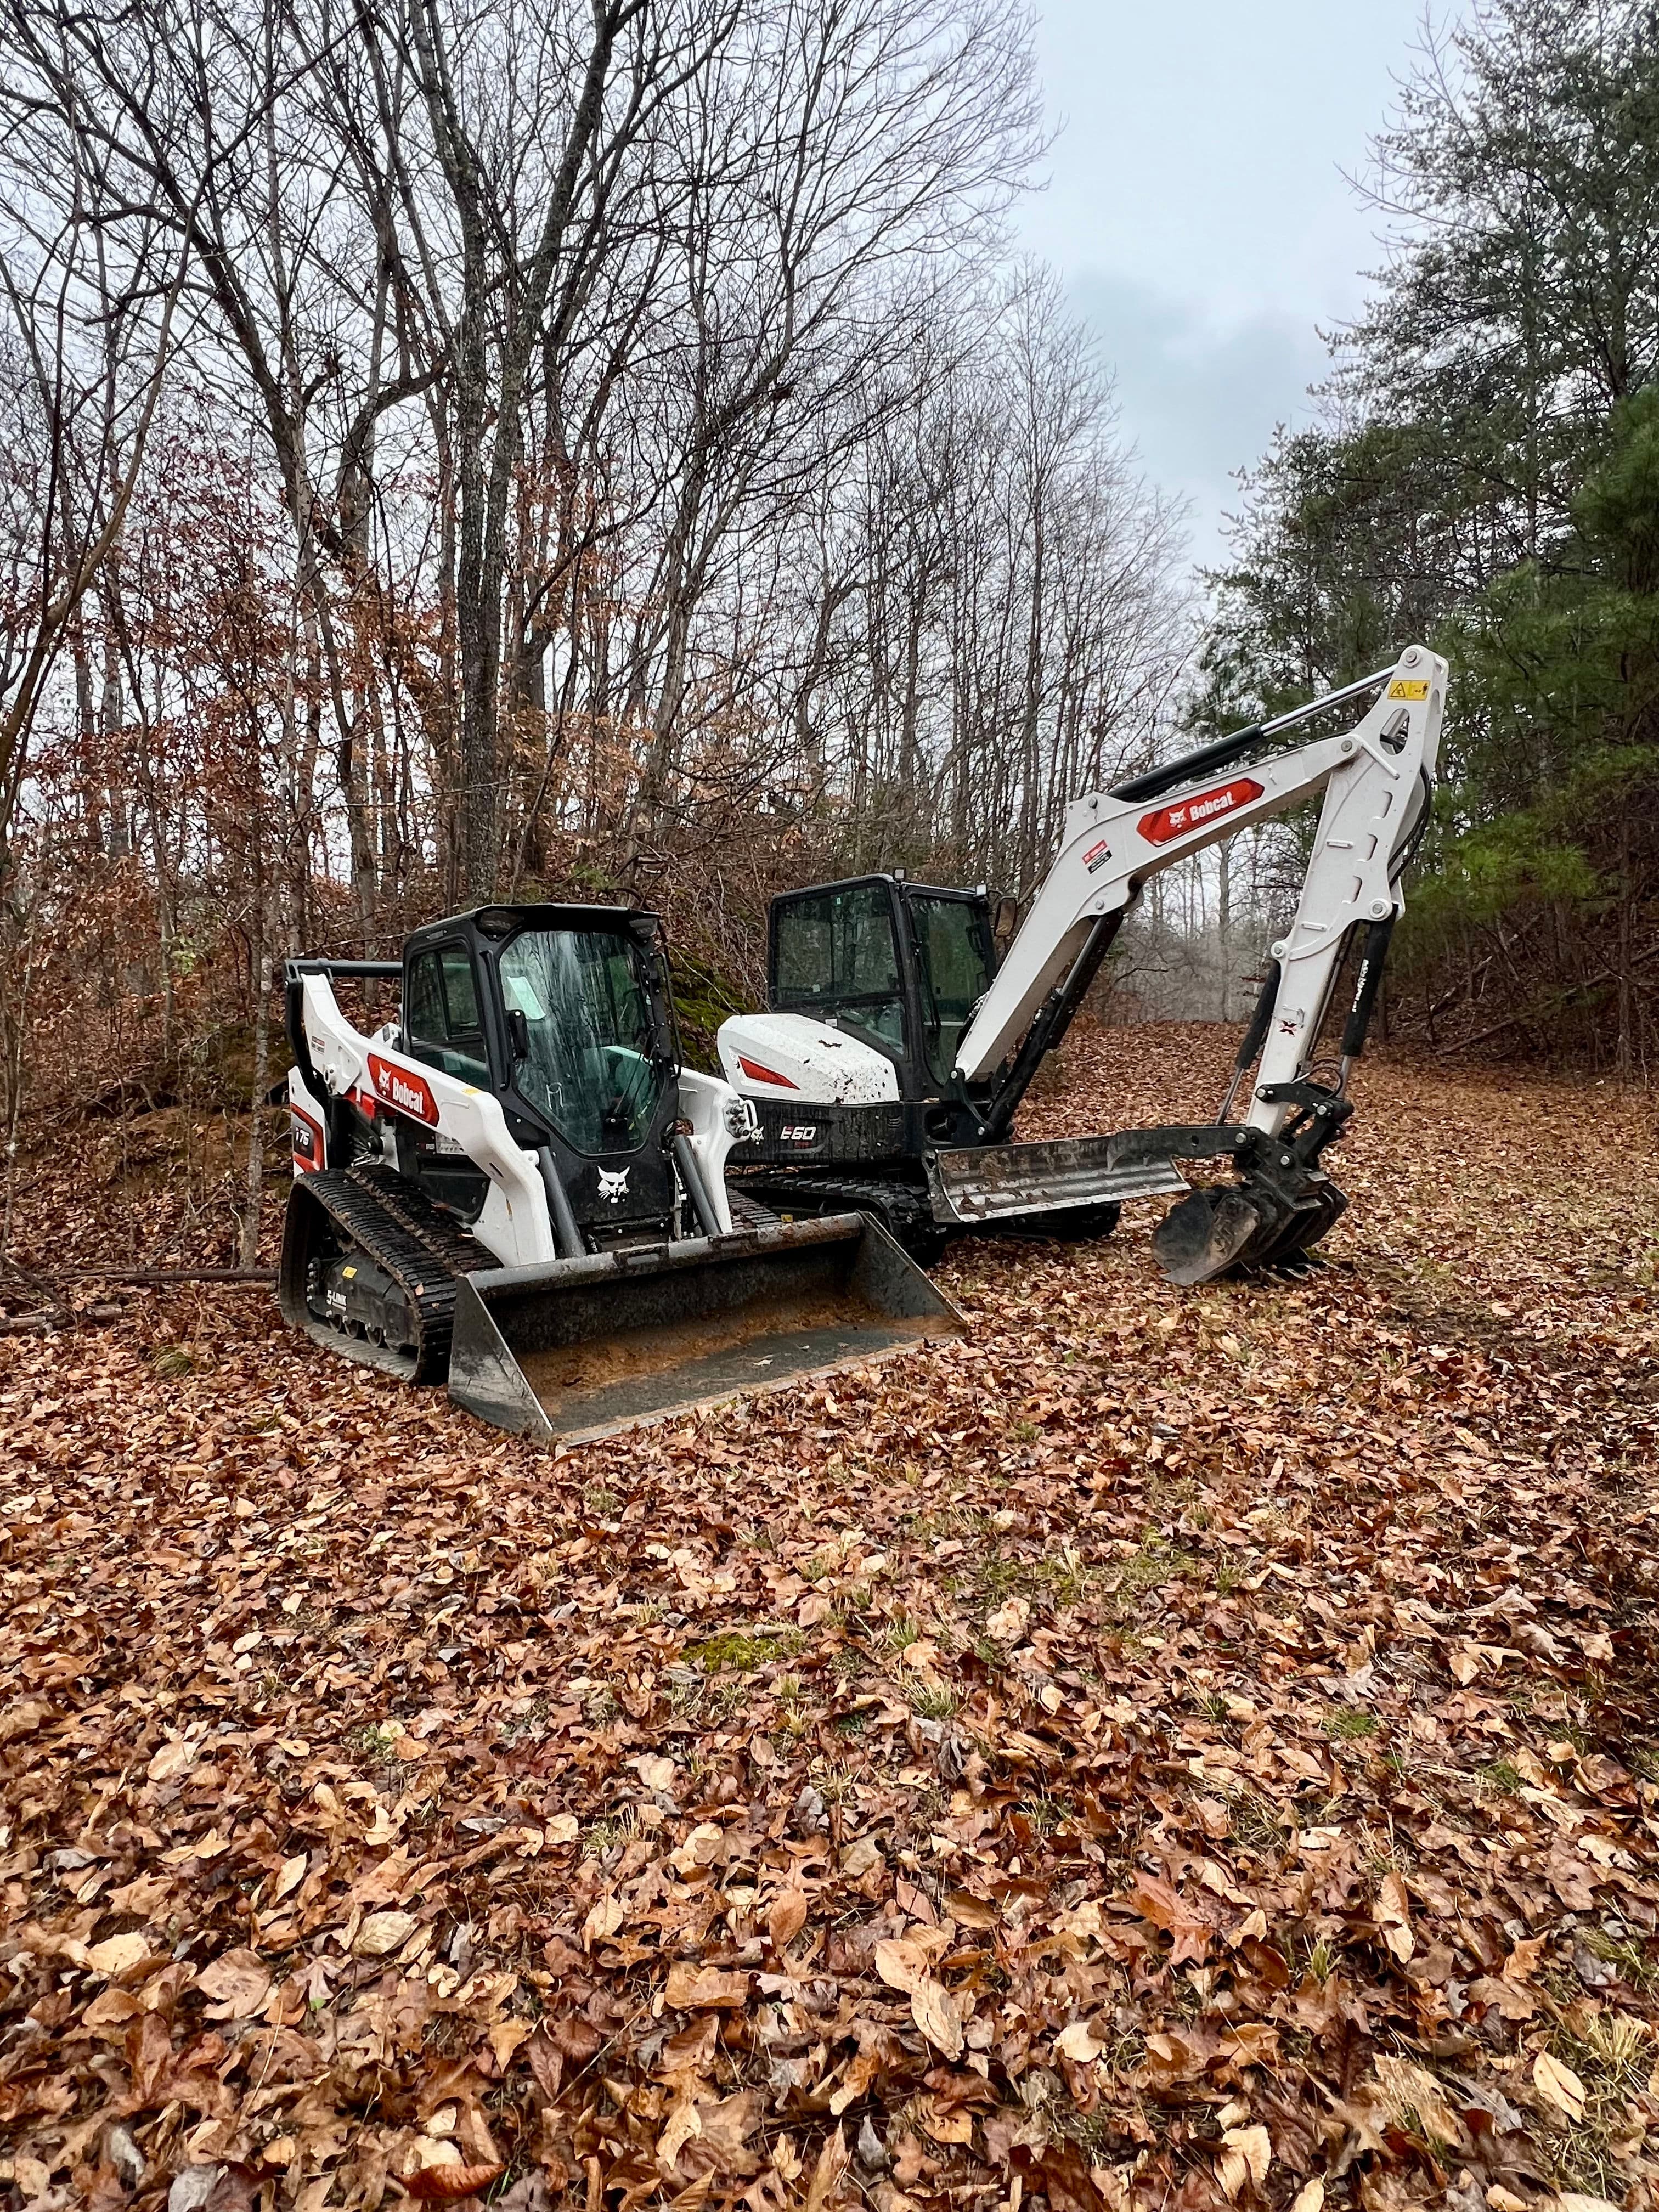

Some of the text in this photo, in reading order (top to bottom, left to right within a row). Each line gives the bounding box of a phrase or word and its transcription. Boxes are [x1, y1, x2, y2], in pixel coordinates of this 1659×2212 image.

[1189, 791, 1235, 822] Bobcat
[393, 1076, 424, 1115] Bobcat
[780, 1126, 816, 1141] E60
